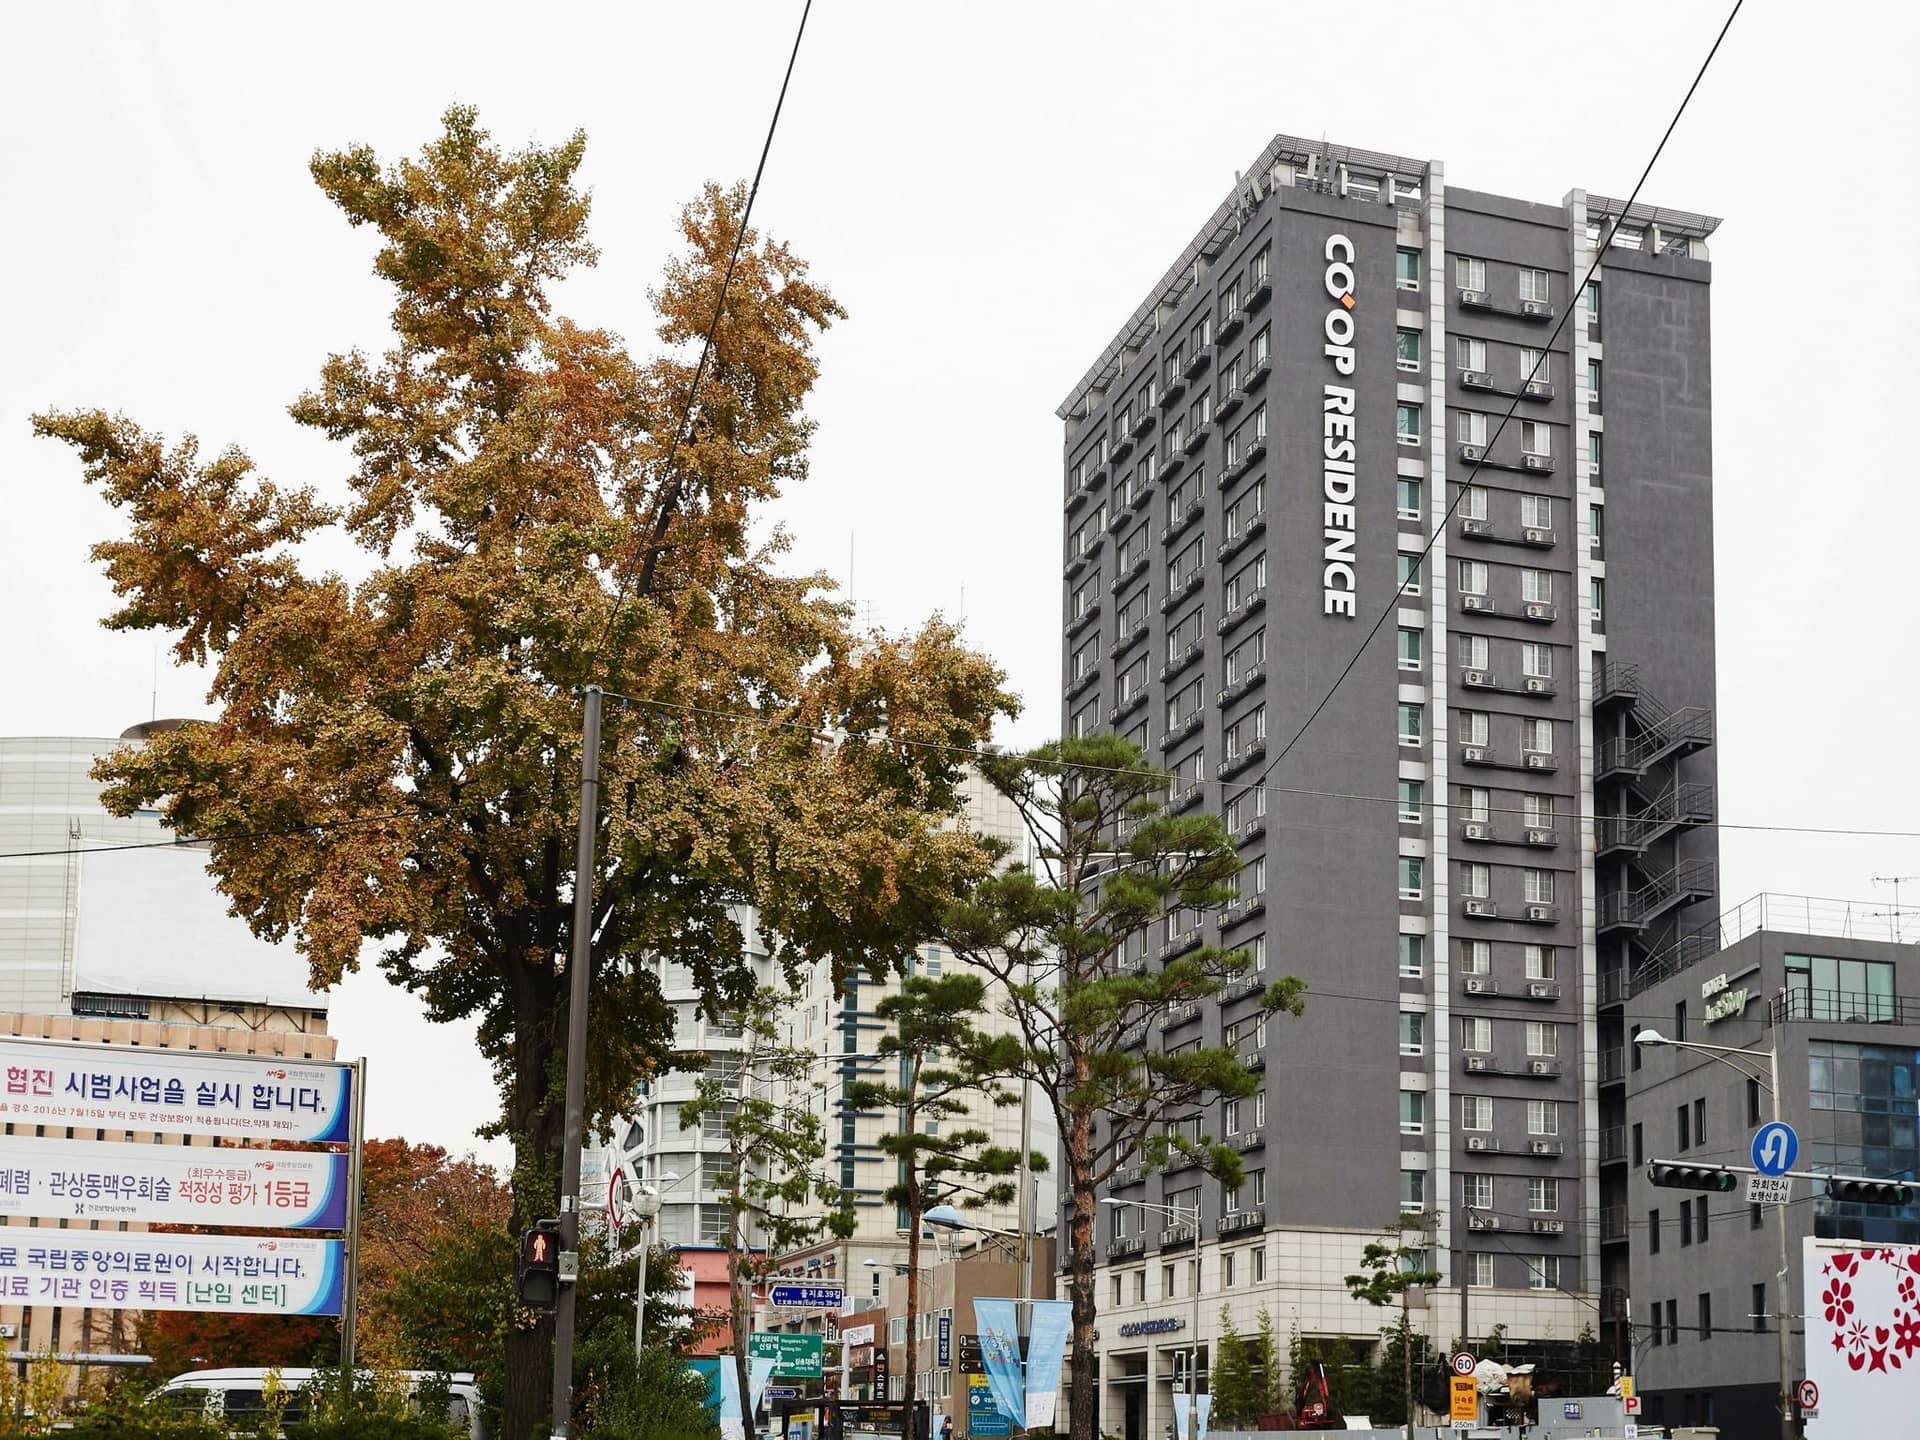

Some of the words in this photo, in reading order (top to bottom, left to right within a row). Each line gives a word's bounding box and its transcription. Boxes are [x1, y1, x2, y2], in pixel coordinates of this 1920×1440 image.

[1323, 384, 1356, 618] RESIDENCE
[7, 1066, 53, 1095] 협진
[65, 1072, 185, 1104] 시범사업을
[196, 1081, 241, 1109] 실시
[253, 1084, 326, 1113] 합니다.
[33, 1104, 67, 1117] 2016년
[70, 1106, 105, 1119] 7월15일
[108, 1110, 126, 1121] 부터
[129, 1111, 147, 1121] 모두
[150, 1112, 193, 1124] 건강보험이
[187, 1167, 252, 1182] (최우수등급)
[0, 1169, 31, 1195] 폐렴
[50, 1172, 172, 1202] 관상동맥우회술
[179, 1180, 223, 1204] 적정성
[228, 1183, 258, 1206] 평가
[264, 1180, 310, 1208] 1등급
[1751, 1179, 1788, 1191] 좌회전시
[1750, 1191, 1787, 1202] 보행신호시
[28, 1248, 193, 1275] 국립중앙의료원이
[202, 1254, 306, 1278] 시작합니다.
[40, 1277, 81, 1298] 기관
[90, 1278, 129, 1301] 인증
[138, 1279, 177, 1302] 획득
[186, 1281, 232, 1305] [난임
[241, 1284, 287, 1307] 센터]
[801, 1289, 841, 1299] 을지로39길
[1457, 1359, 1472, 1370] 60
[1626, 1398, 1638, 1413] P
[1454, 1421, 1475, 1429] 250m
